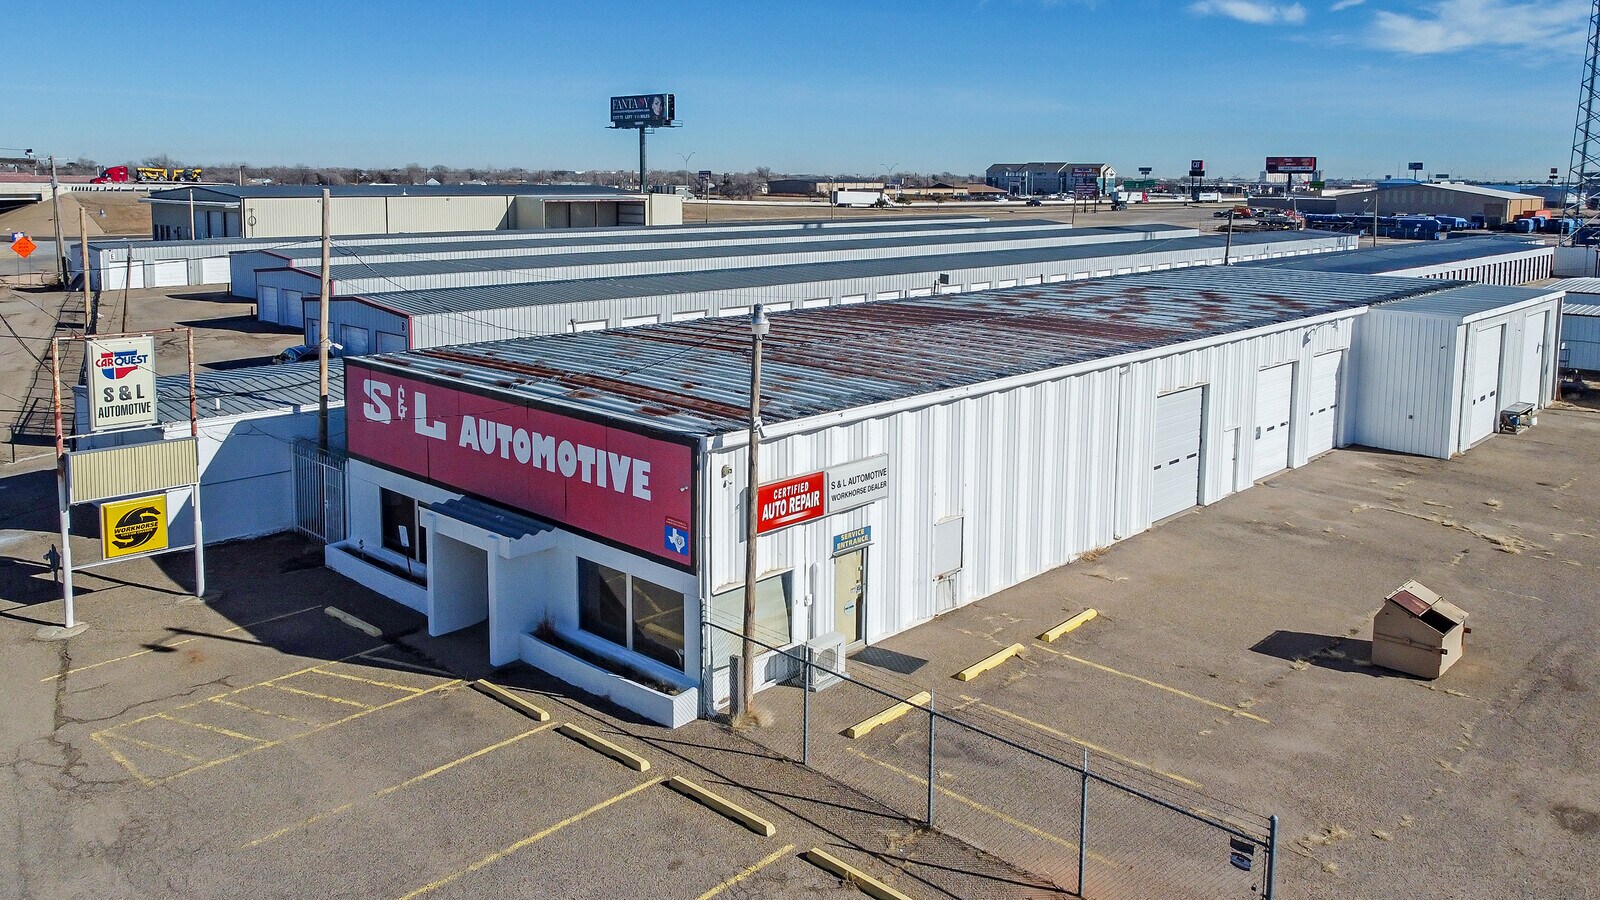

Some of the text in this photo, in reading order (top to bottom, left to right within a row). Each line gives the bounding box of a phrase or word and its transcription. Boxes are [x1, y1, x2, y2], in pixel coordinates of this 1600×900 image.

[96, 354, 148, 368] CARQUEST
[103, 384, 145, 402] S & L
[98, 402, 151, 419] AUTOMOTIVE
[363, 378, 651, 501] S & L AUTOMOTIVE
[831, 467, 887, 490] S & L AUTOMOTIVE
[773, 482, 809, 500] CERTIFIED
[831, 481, 887, 502] WORKHORSE DEALER
[762, 490, 820, 521] AUTO REPAIR
[114, 522, 158, 534] WORKHORSE
[841, 528, 865, 541] SERVICE
[837, 535, 869, 549] ENTRANCE
